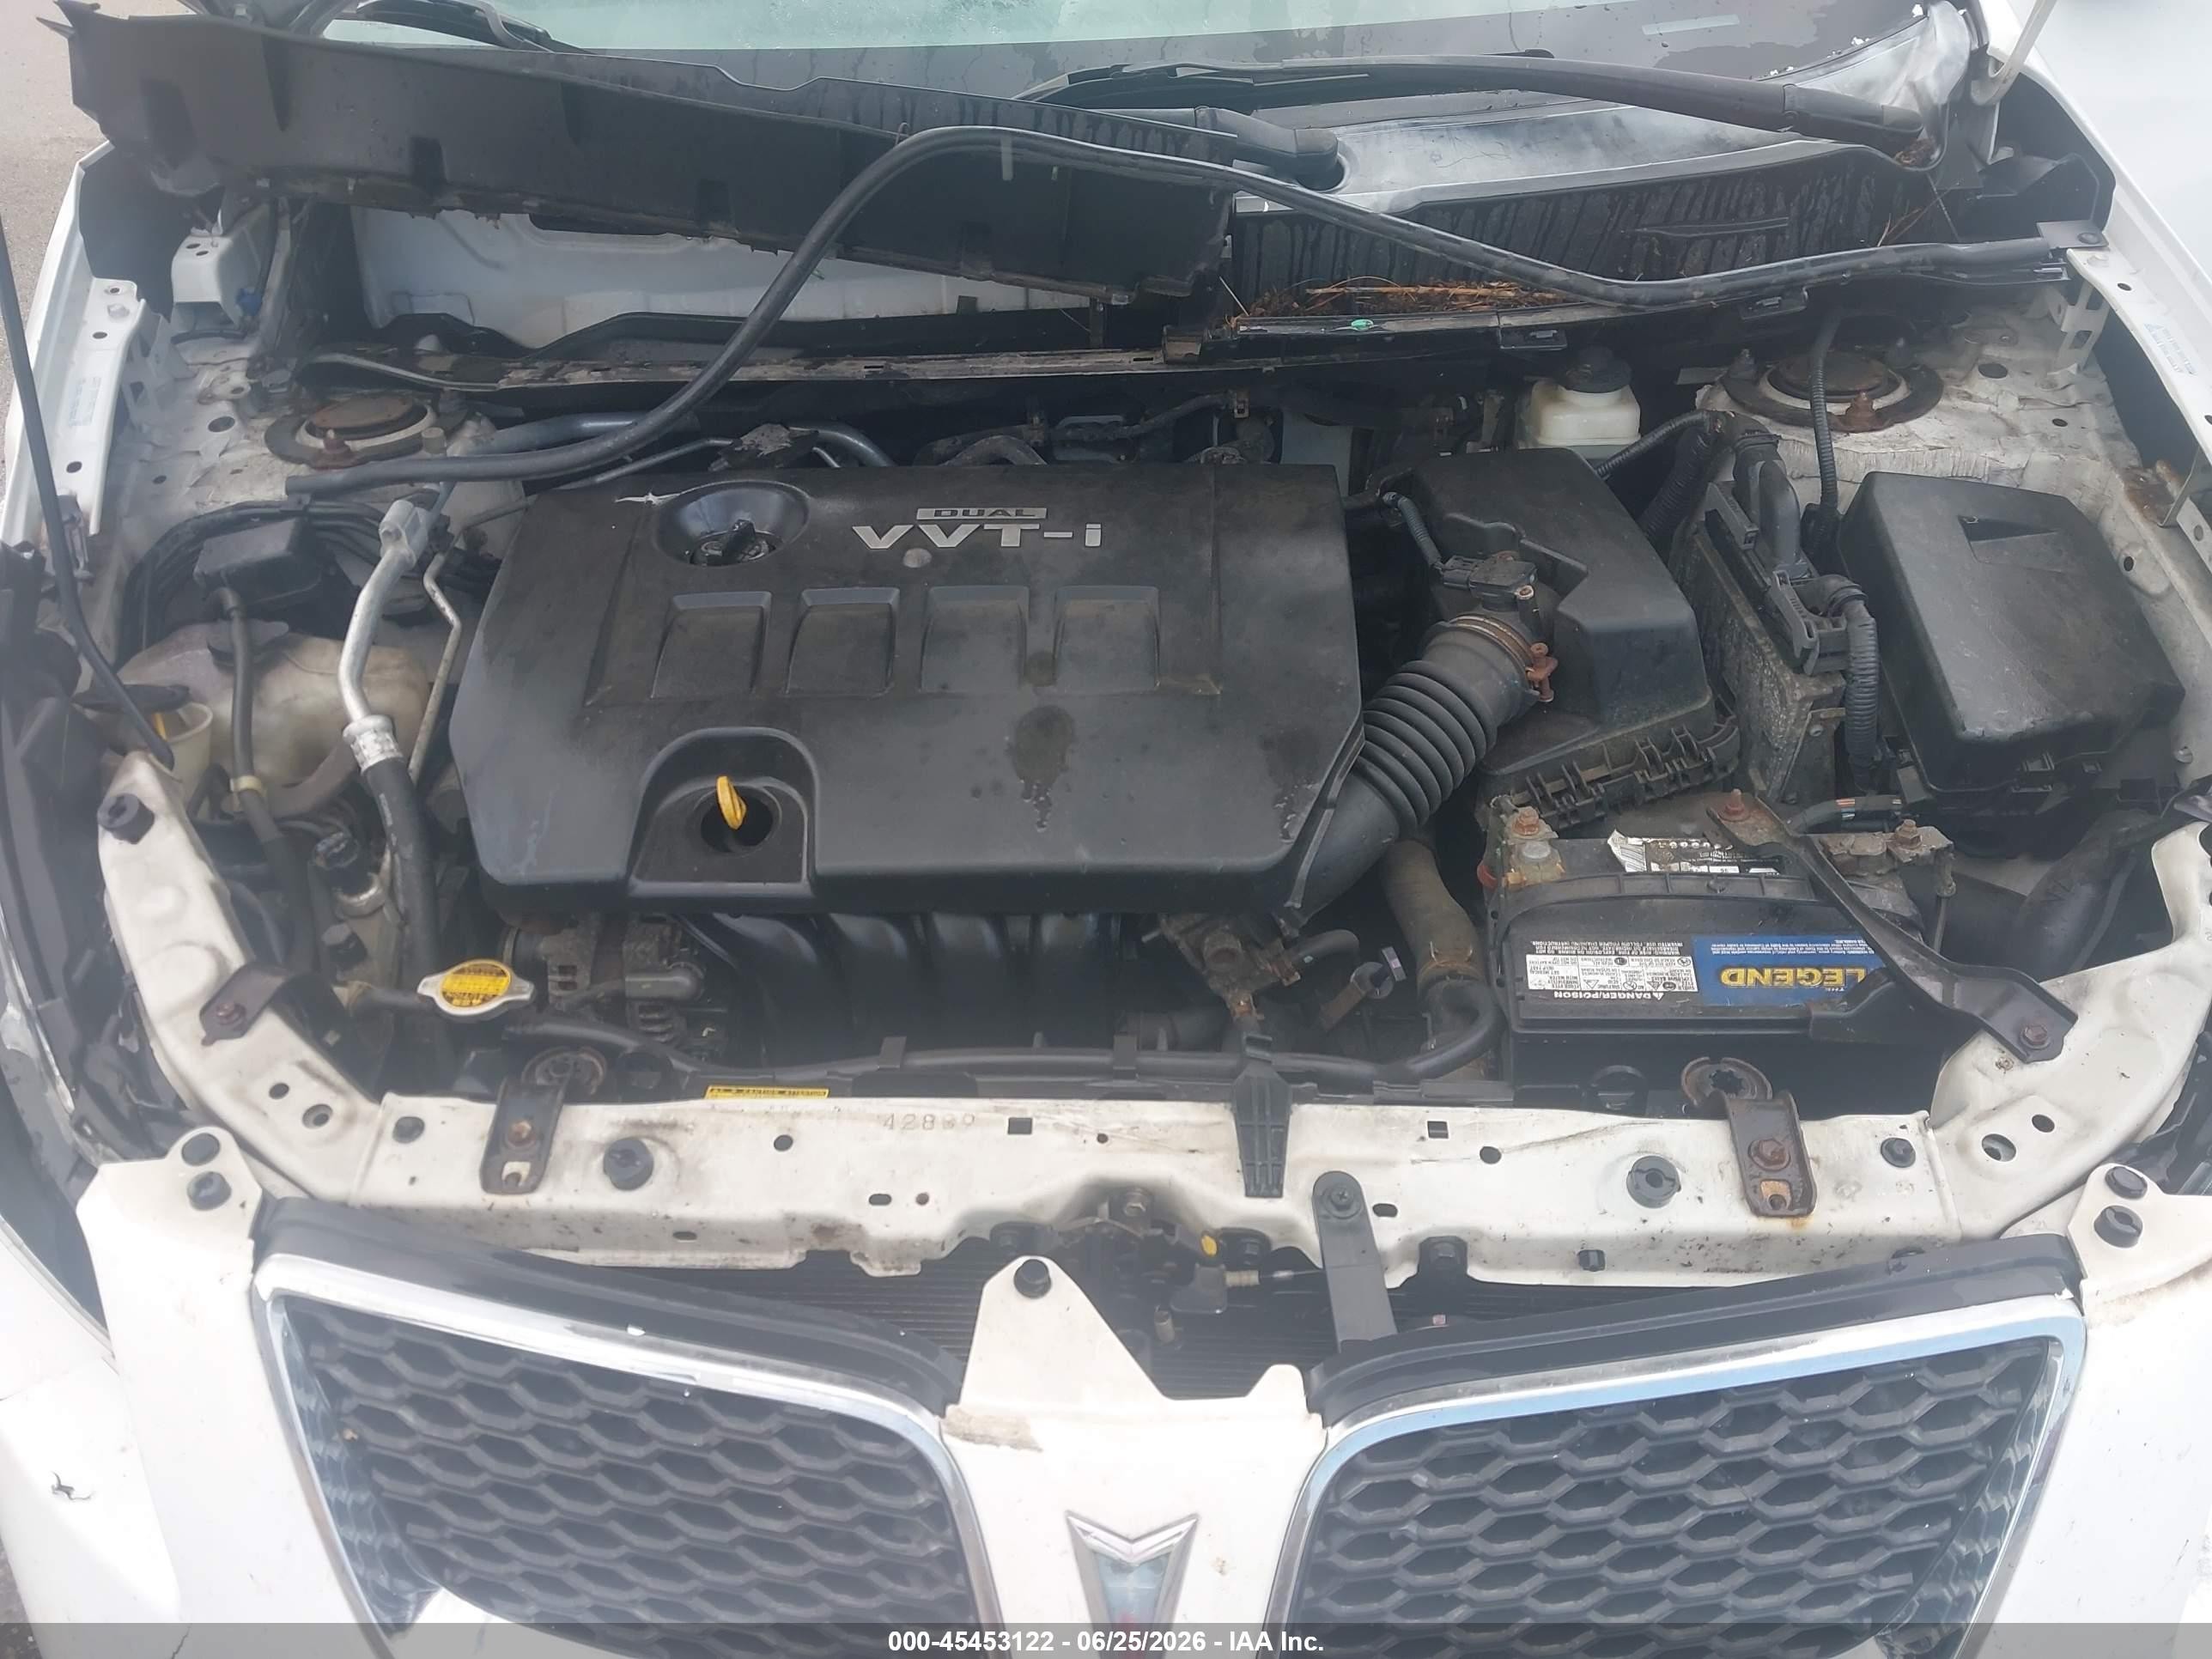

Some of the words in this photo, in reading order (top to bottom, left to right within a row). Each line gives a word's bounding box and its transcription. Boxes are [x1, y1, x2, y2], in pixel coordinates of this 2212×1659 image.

[934, 508, 1036, 517] DUAL
[852, 524, 1102, 550] VVT-i
[1720, 967, 1867, 987] LEGEND
[1553, 991, 1652, 1000] DANGER/POISON
